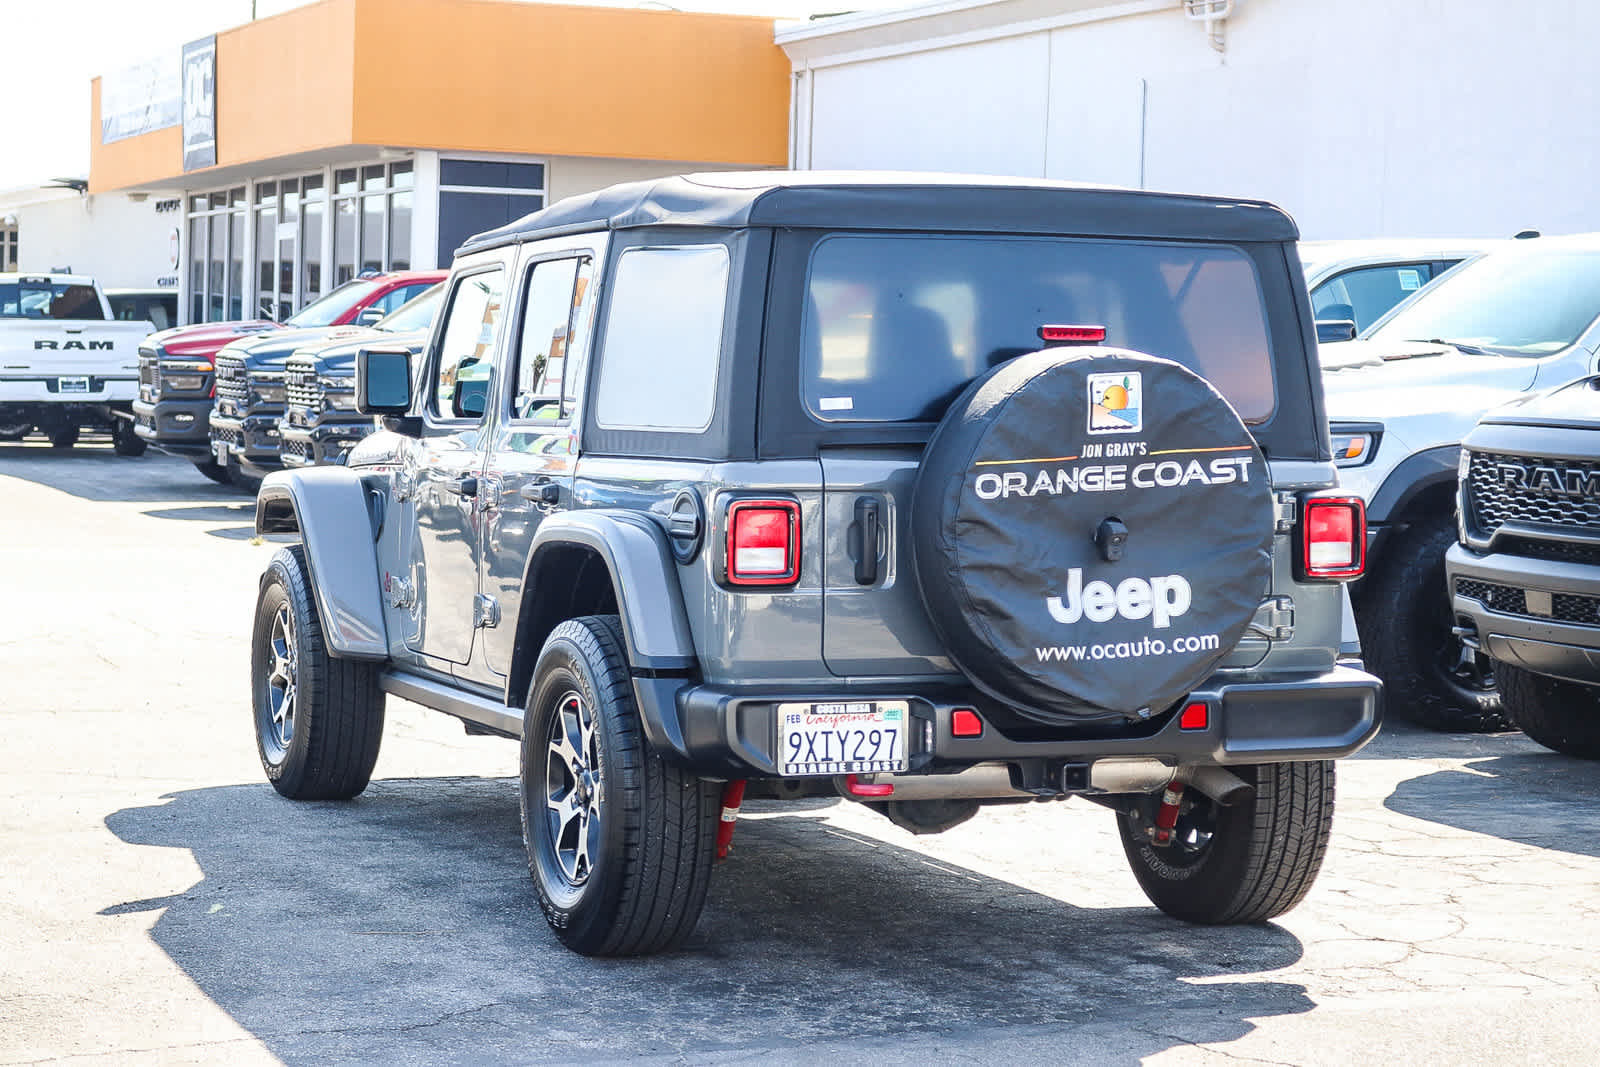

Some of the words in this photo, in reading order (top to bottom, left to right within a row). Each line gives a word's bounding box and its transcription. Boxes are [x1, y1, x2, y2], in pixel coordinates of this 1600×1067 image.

[34, 340, 114, 350] RAM
[1080, 444, 1103, 459] JON
[1106, 442, 1147, 458] GRAY'S
[975, 464, 1126, 499] ORANGE
[1132, 457, 1253, 489] COAST
[1497, 463, 1600, 496] RAM
[1047, 567, 1192, 629] Jeep
[1036, 632, 1220, 662] www.ocauto.com
[786, 714, 801, 724] FEB
[806, 713, 883, 728] California
[789, 729, 897, 762] 9XIY297
[787, 763, 847, 774] ORANGE
[852, 761, 901, 772] COAST
